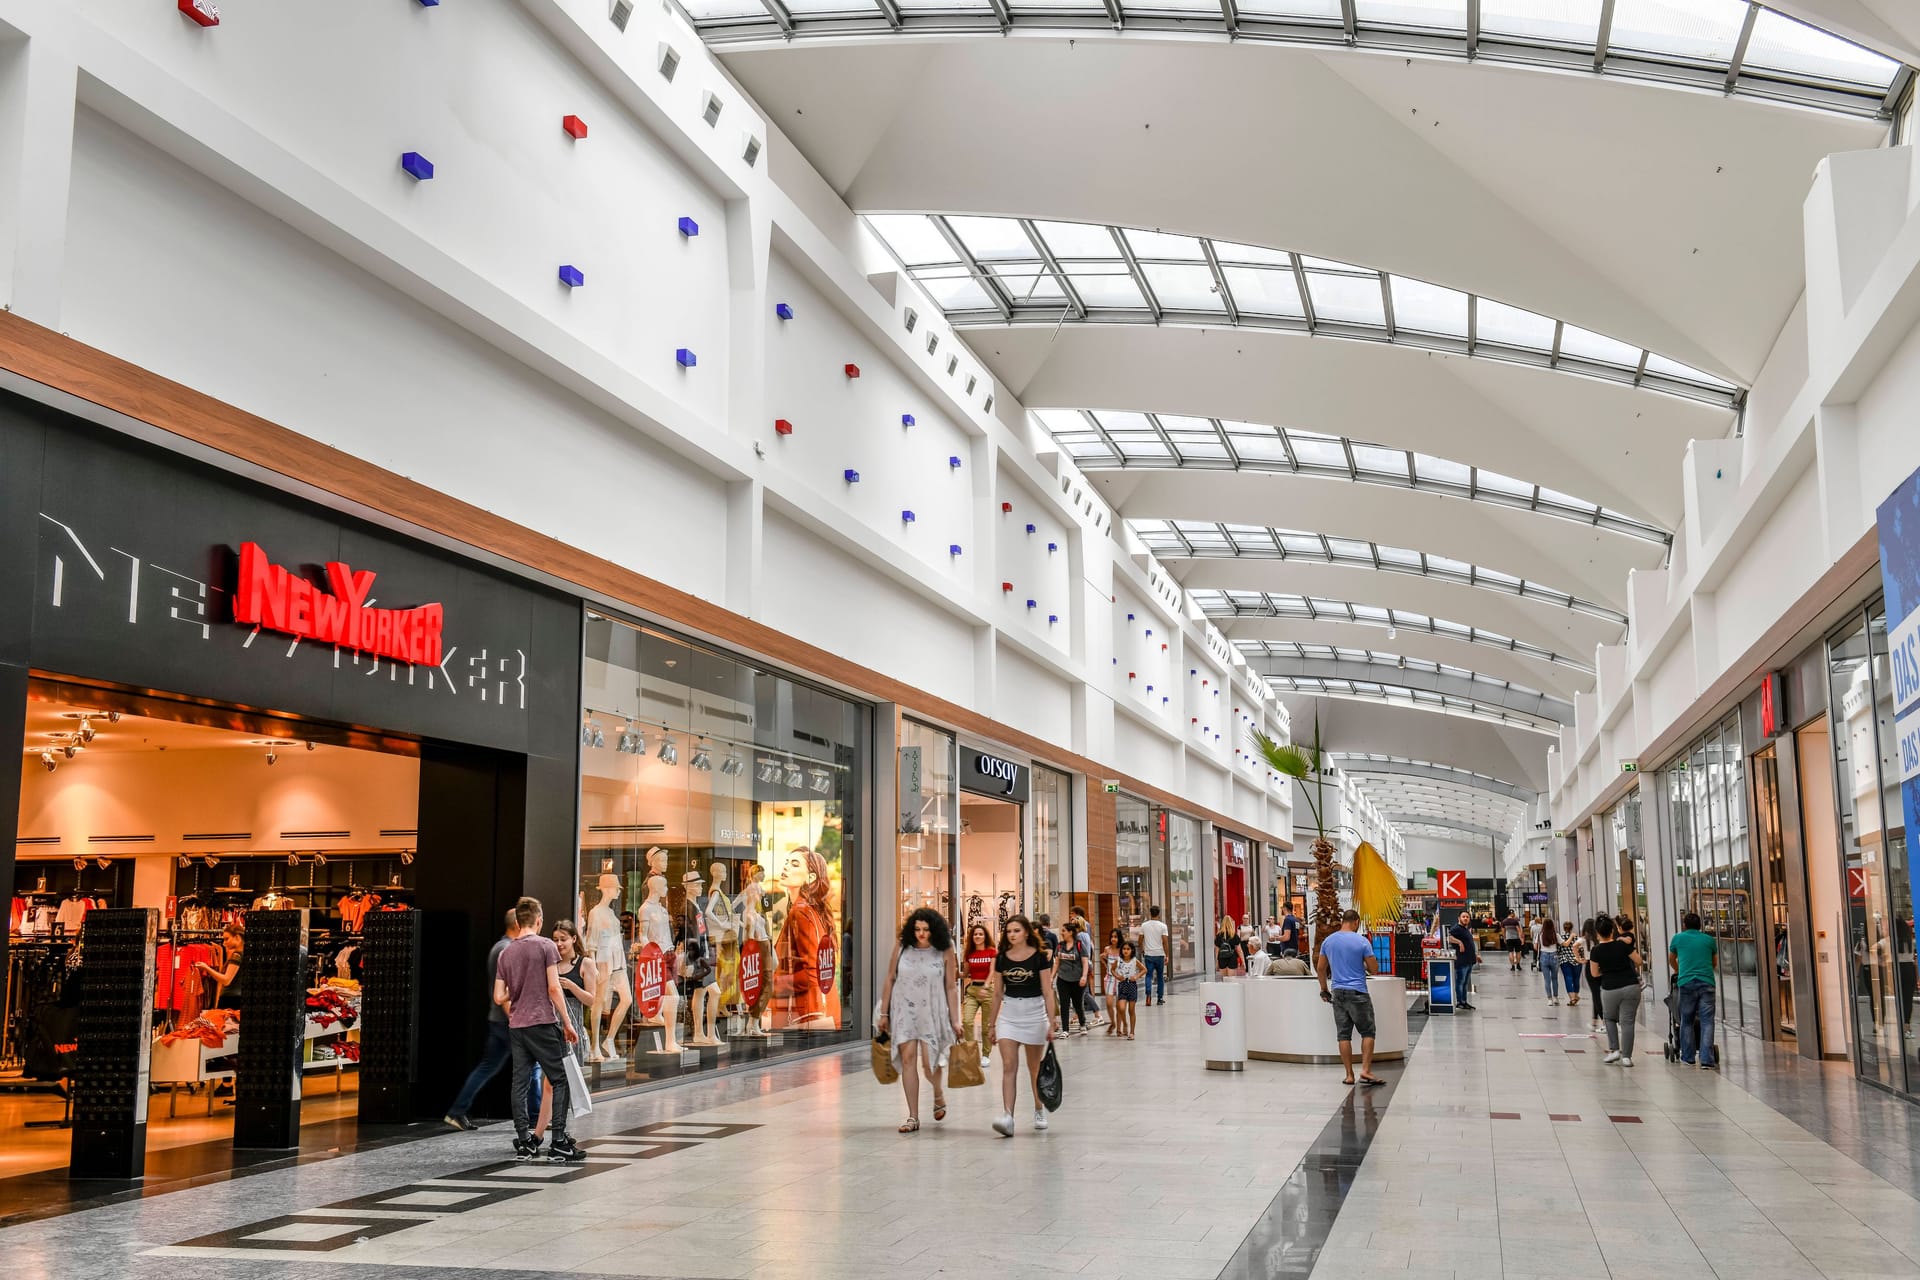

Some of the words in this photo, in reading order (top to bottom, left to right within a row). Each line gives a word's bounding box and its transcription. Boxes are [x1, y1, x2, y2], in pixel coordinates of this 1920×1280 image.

[1892, 632, 1920, 705] DAS
[1902, 731, 1919, 774] DAS
[981, 755, 1018, 795] orsay
[1443, 872, 1461, 897] K
[640, 958, 663, 989] SALE
[742, 952, 760, 980] SALE
[819, 947, 834, 971] SALE
